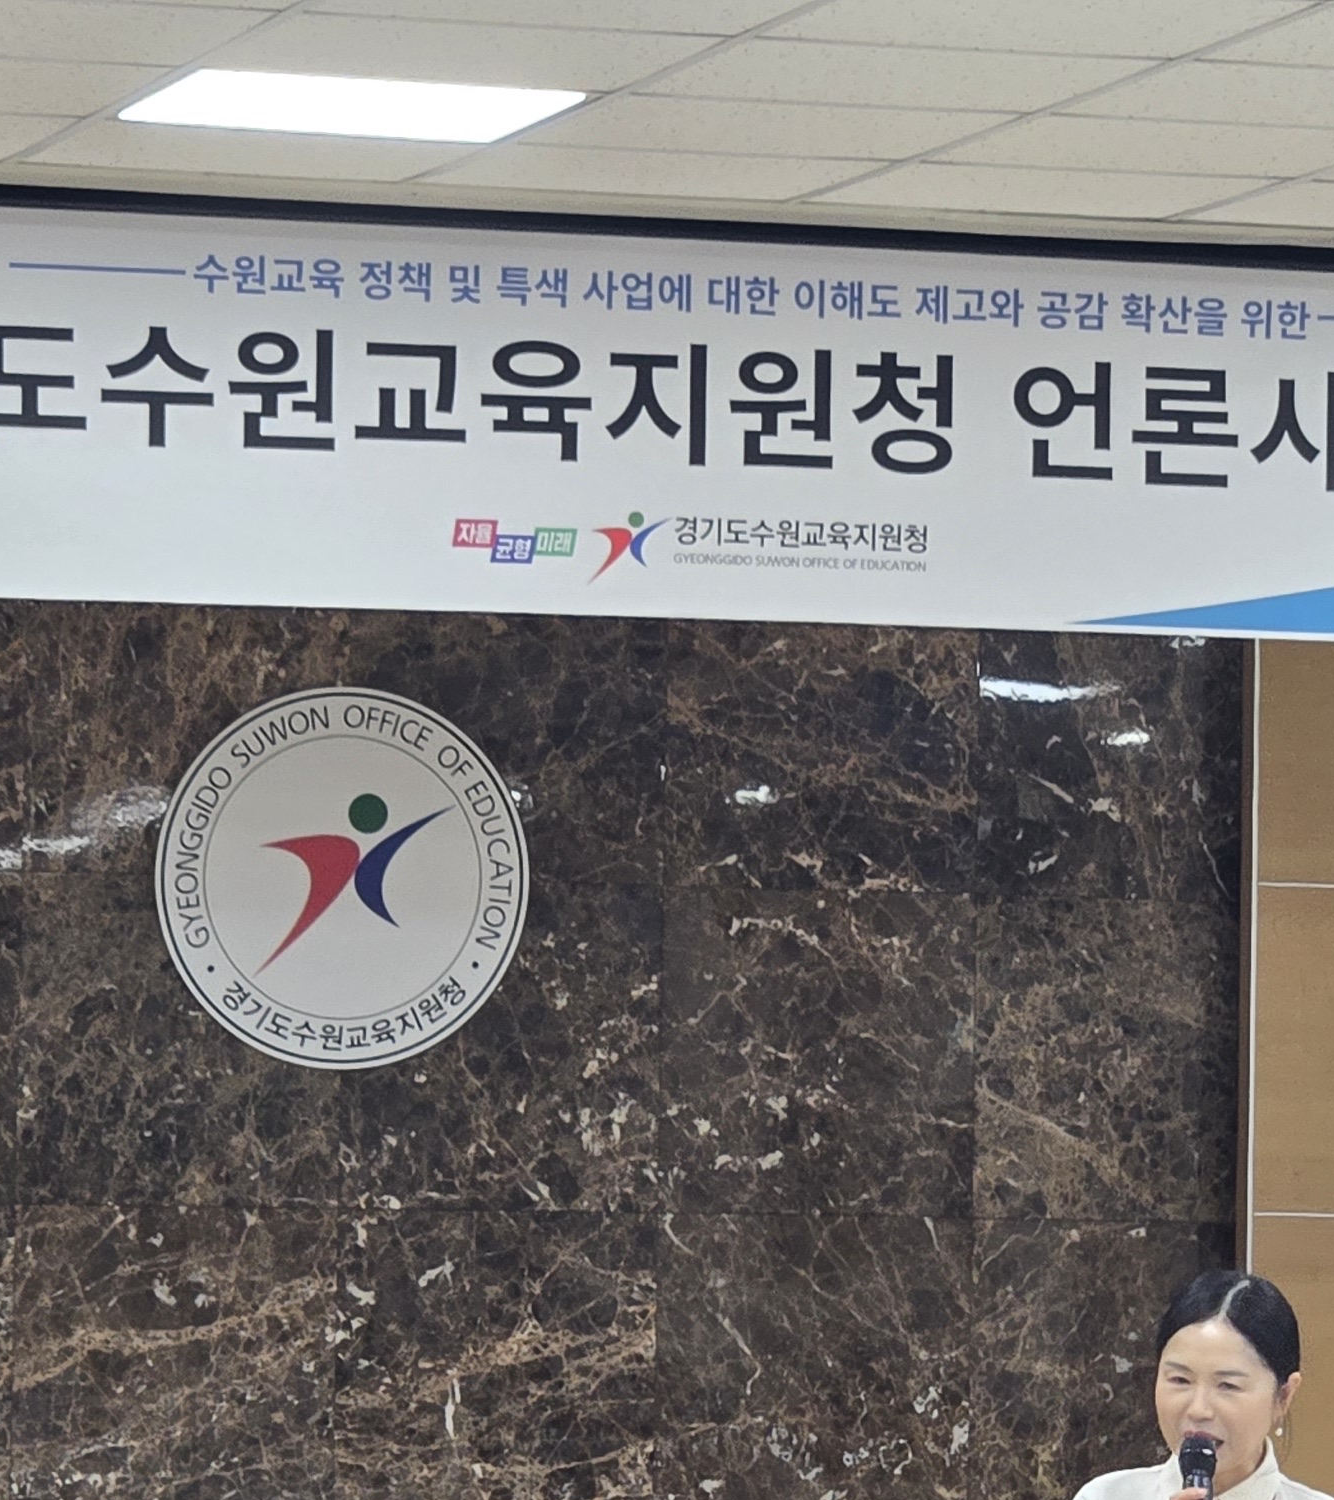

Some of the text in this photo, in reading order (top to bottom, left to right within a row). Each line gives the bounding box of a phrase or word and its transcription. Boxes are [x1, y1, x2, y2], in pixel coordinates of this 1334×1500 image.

[192, 254, 1311, 341] 수원교육 정책 및 특색 사업에 대한 이해도 제고와 공감 확산을 위한
[457, 522, 573, 560] 자율 균형 미래
[673, 516, 929, 554] 경기도수원교육지원청
[673, 552, 927, 573] GYEONGGIDO SUWON OFFICE OF EDUCATION
[174, 703, 515, 952] GYEONGGIDO SUWON OFFICE OF EDUCATION
[221, 975, 468, 1053] 경기도수원교육지원청
